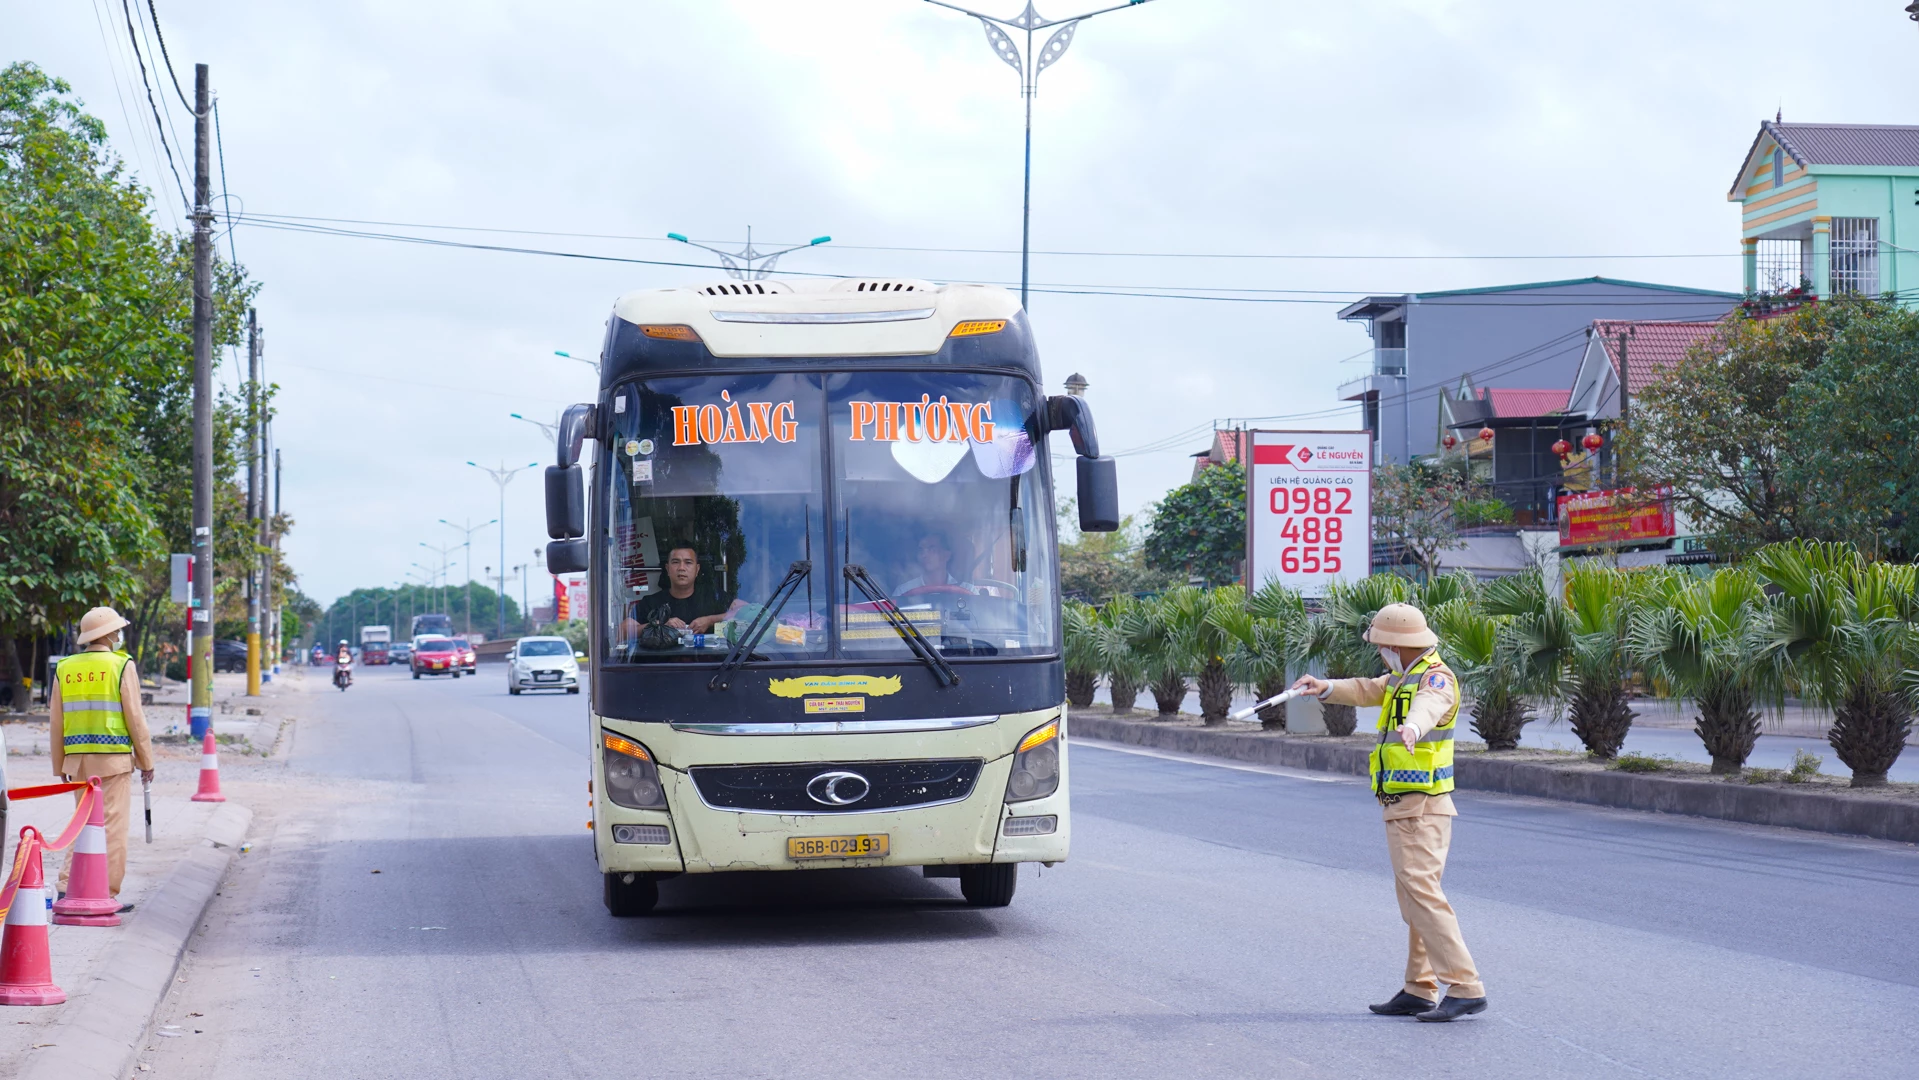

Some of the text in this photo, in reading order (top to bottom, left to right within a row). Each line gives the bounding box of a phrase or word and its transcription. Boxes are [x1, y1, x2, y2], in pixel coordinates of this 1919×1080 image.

[671, 389, 995, 446] HOÀNG PHƯƠNG
[1270, 475, 1354, 486] LIÊN HỆ QUẢNG CÁO
[1270, 487, 1353, 514] 0982
[1280, 517, 1343, 544] 488
[1281, 546, 1342, 573] 655
[797, 838, 880, 854] 36B-029.93
